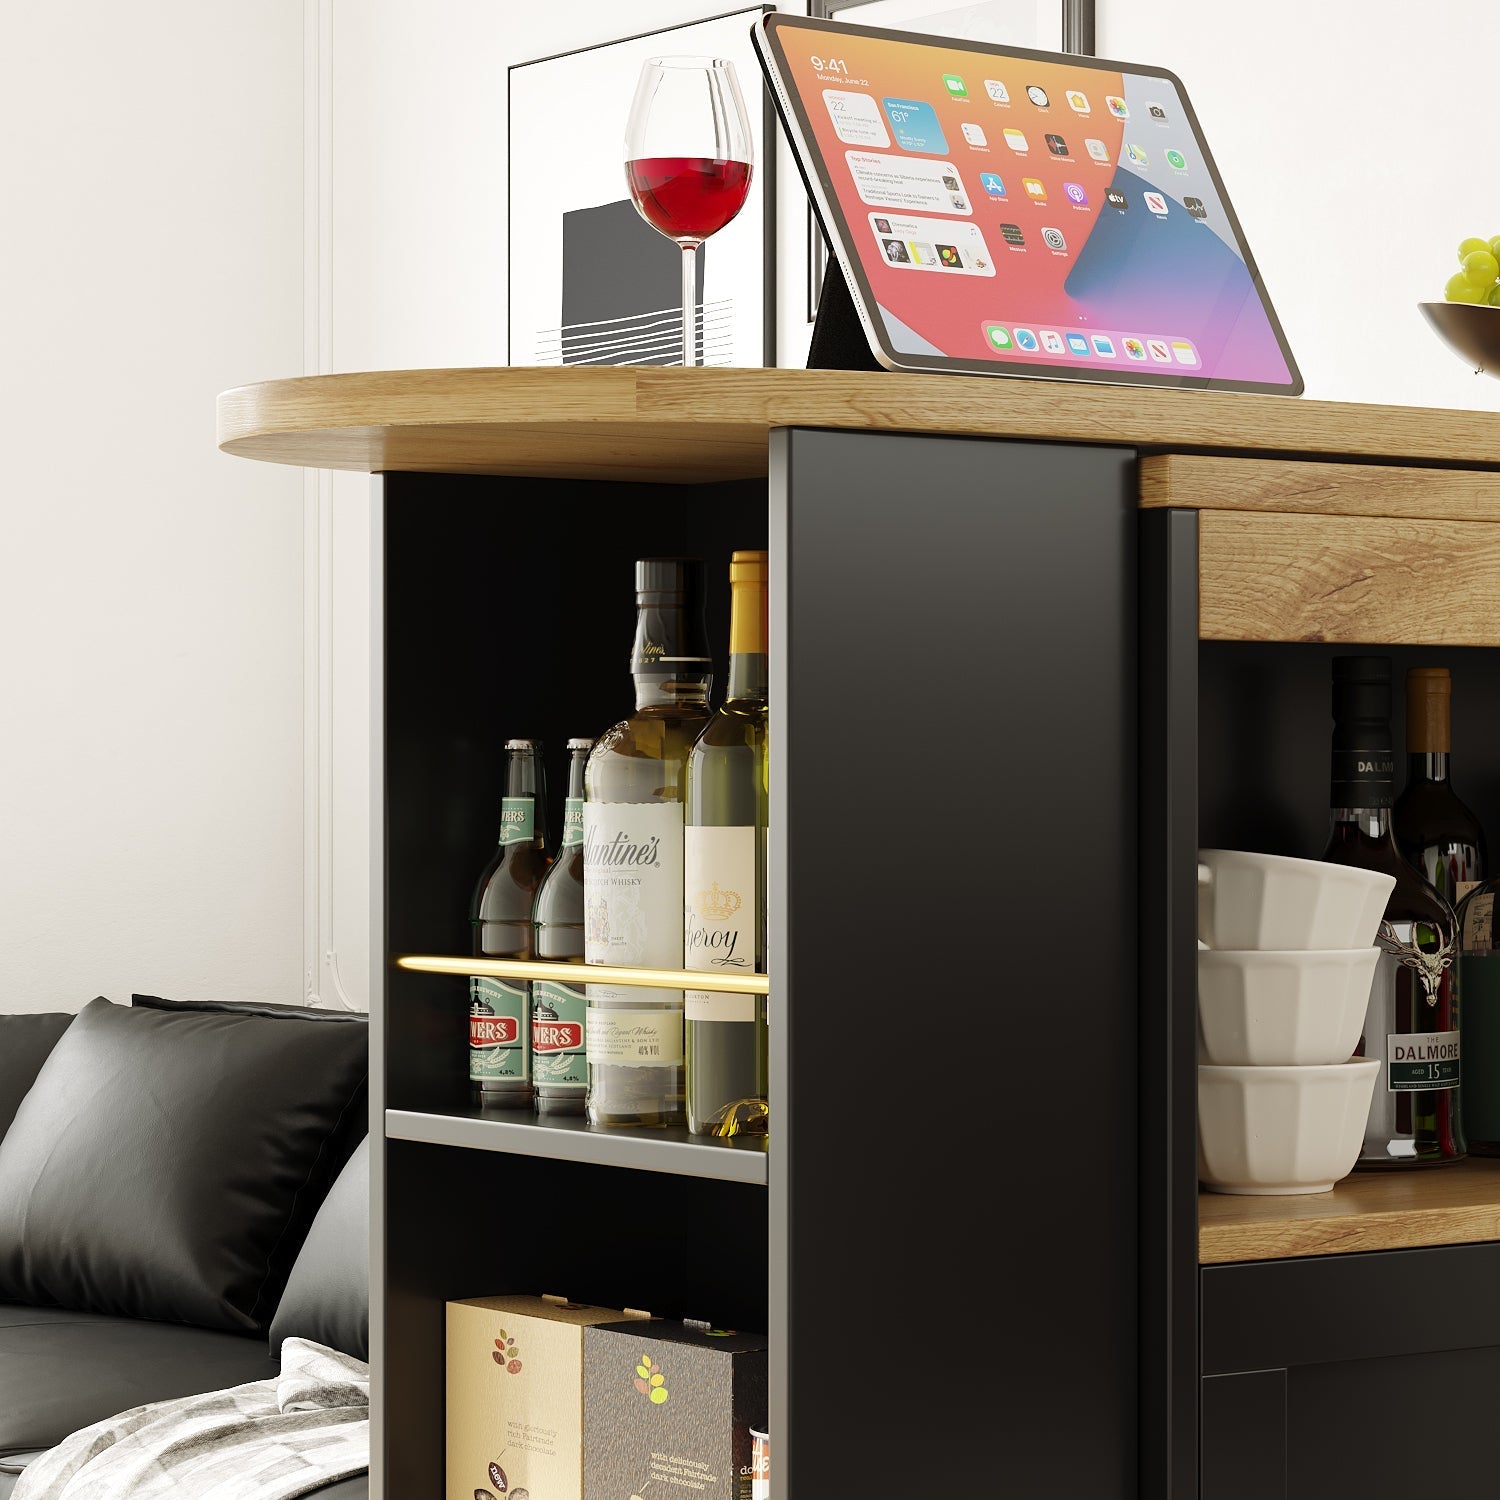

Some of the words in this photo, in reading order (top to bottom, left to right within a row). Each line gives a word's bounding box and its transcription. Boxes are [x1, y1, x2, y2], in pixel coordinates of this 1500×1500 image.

[810, 55, 848, 74] 9:41
[817, 74, 844, 83] Monday,
[990, 87, 1005, 98] 22
[831, 101, 846, 112] 22
[850, 155, 861, 163] Top
[861, 156, 881, 164] Stories
[611, 878, 642, 886] WHISKY
[1395, 1043, 1458, 1060] DALMORE
[1428, 1064, 1440, 1079] 15
[508, 1431, 520, 1439] rich
[523, 1433, 553, 1445] Fairtrade
[524, 1424, 558, 1438] gloriously
[507, 1440, 523, 1449] dark
[524, 1444, 556, 1456] chocolate
[651, 1452, 668, 1461] with
[669, 1455, 709, 1471] deliciously
[490, 1466, 505, 1488] new
[651, 1462, 683, 1474] decadent
[684, 1469, 717, 1482] Fairtrade
[651, 1472, 669, 1482] dark
[670, 1477, 705, 1490] chocolate
